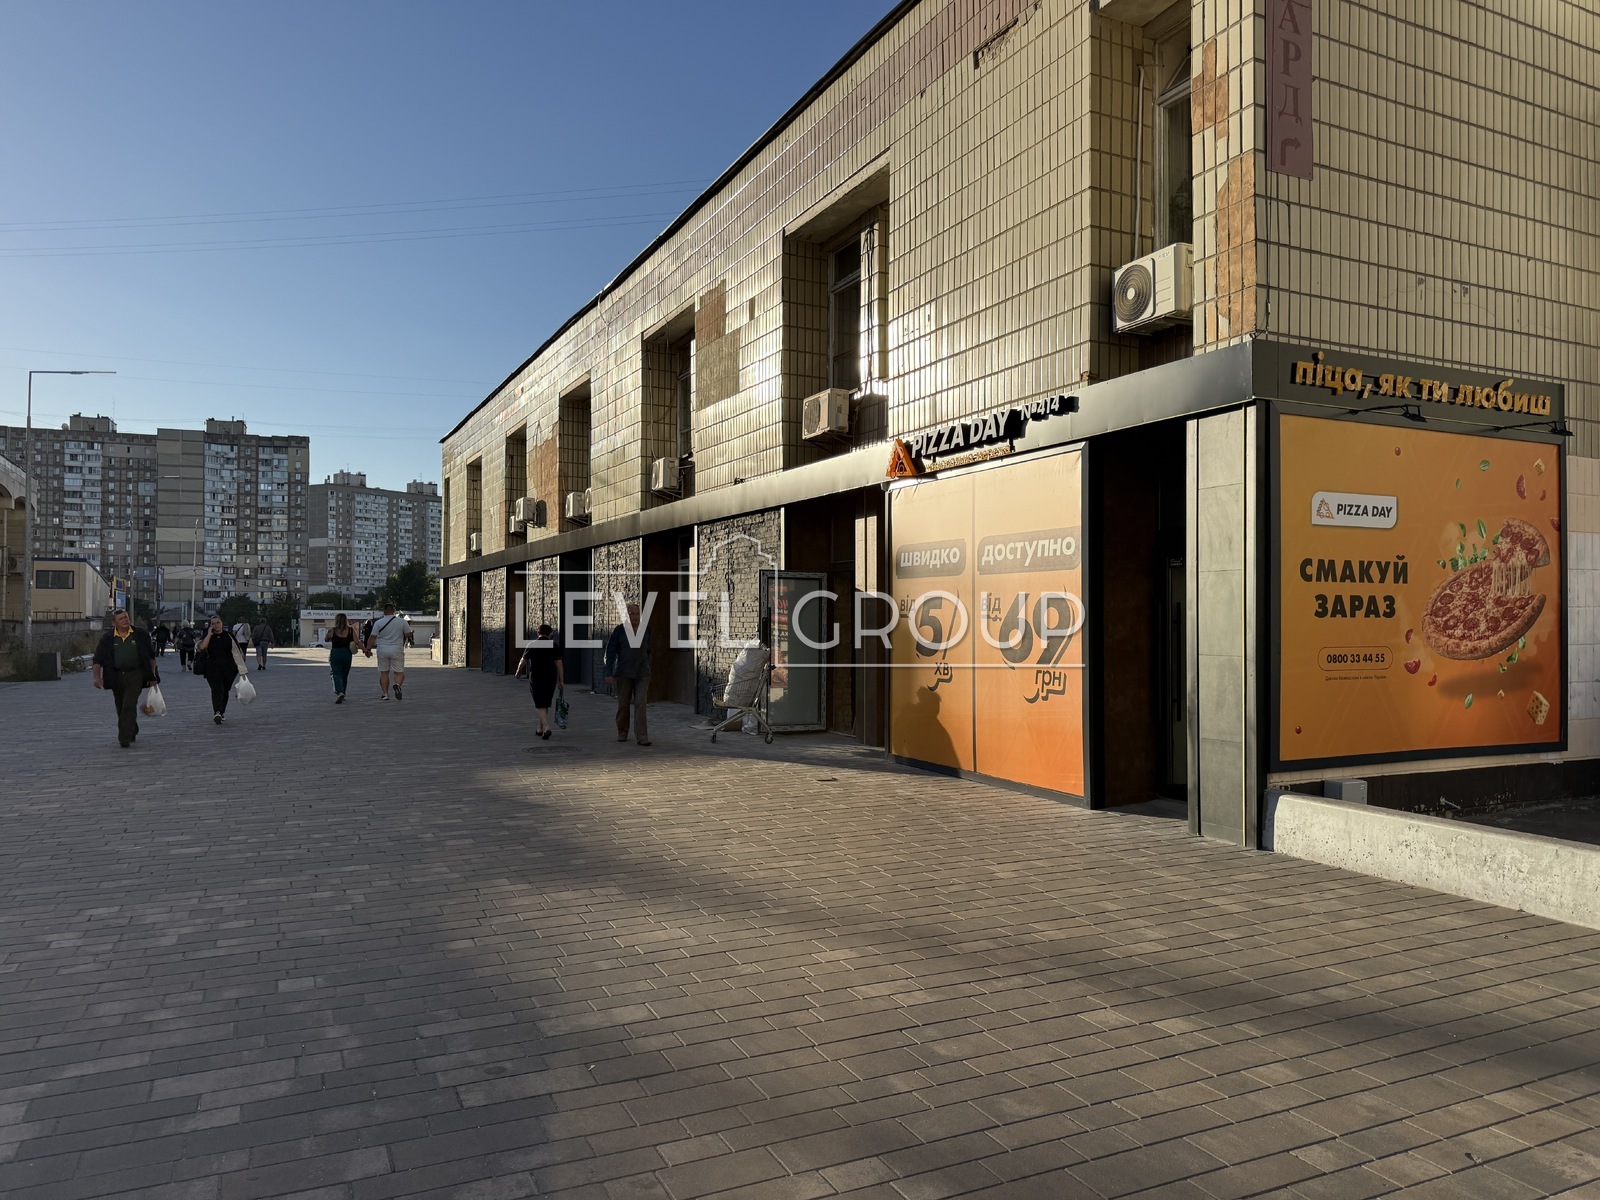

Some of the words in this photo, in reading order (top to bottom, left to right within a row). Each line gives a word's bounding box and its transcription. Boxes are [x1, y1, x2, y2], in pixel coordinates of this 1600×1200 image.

[1295, 350, 1373, 399] піца,
[1378, 373, 1413, 399] як
[1418, 378, 1450, 403] ти
[1455, 378, 1551, 416] любиш
[910, 422, 965, 459] PIZZA
[969, 409, 1011, 444] DAY
[1336, 503, 1369, 518] PIZZA
[1371, 504, 1393, 519] DAY
[1299, 554, 1409, 585] СМАКУЙ
[900, 594, 917, 614] від
[1313, 593, 1397, 619] ЗАРАЗ
[981, 592, 1002, 615] від
[999, 592, 1073, 665] 69
[1326, 653, 1349, 664] 0800
[1350, 653, 1361, 664] 33
[1362, 653, 1373, 663] 44
[1374, 653, 1385, 663] 55
[1034, 668, 1063, 693] грн
